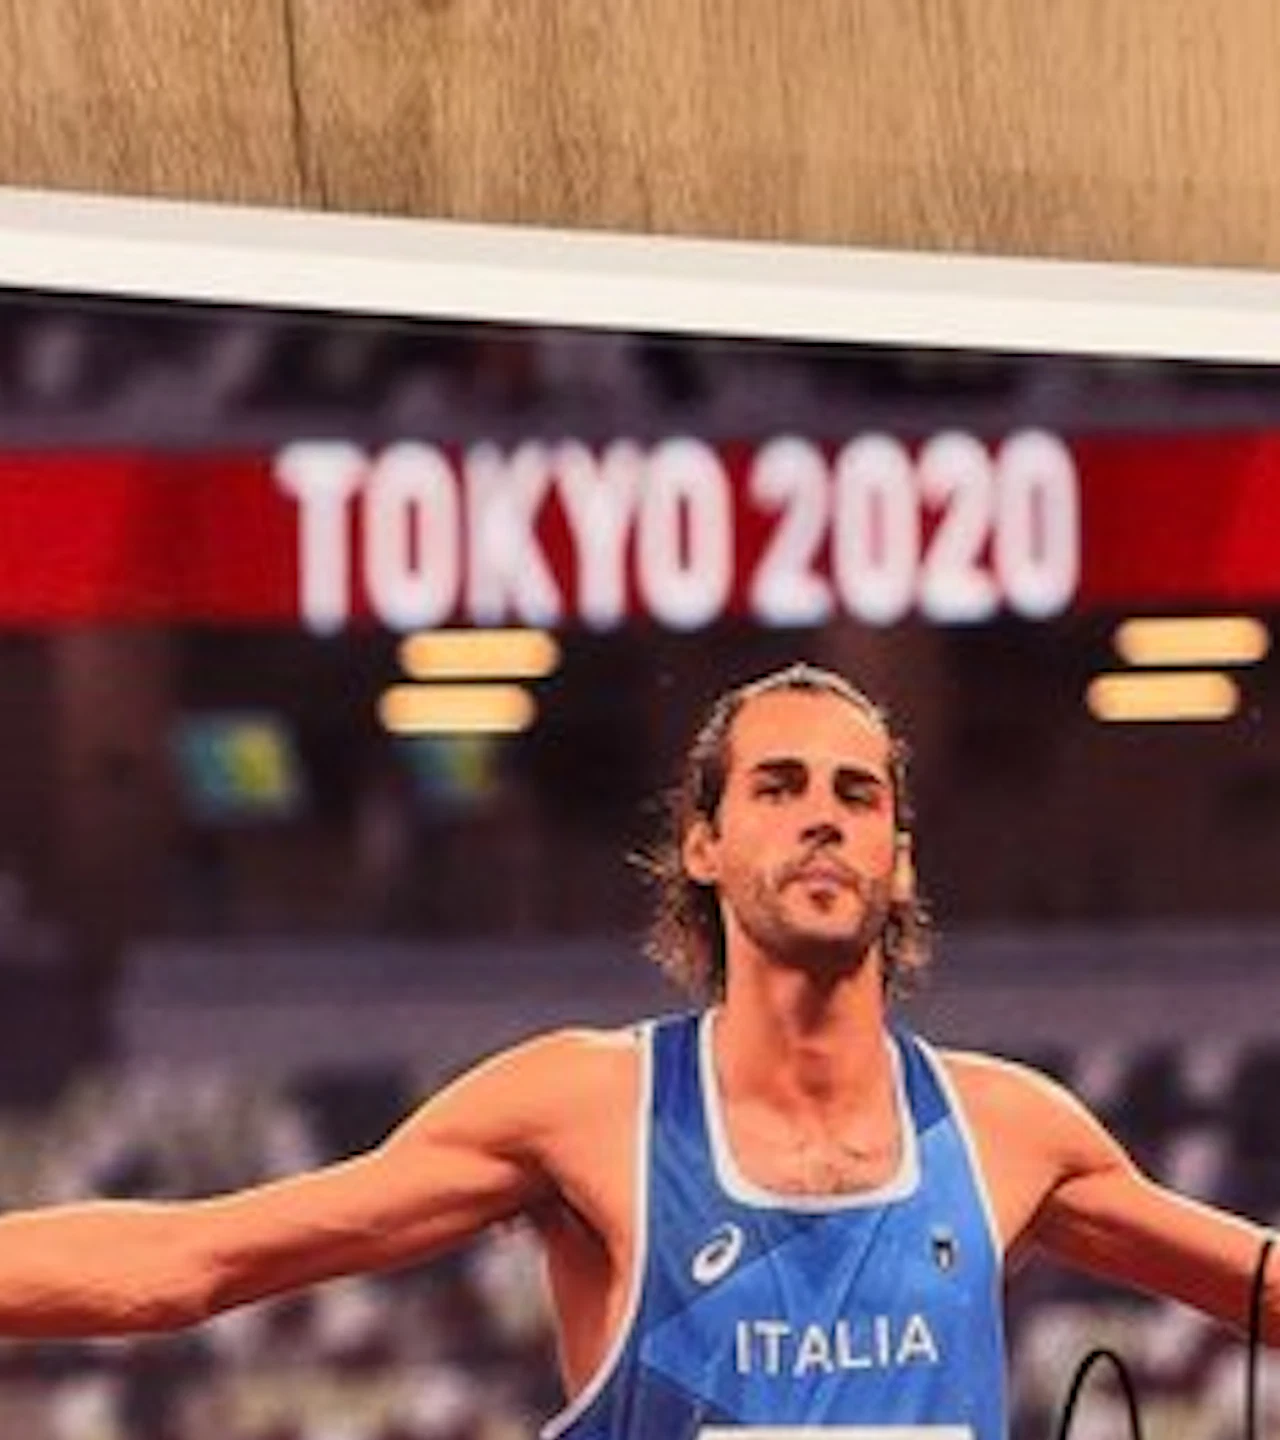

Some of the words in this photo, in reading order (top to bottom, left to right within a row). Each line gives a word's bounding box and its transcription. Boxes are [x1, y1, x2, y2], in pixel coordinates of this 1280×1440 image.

[276, 438, 732, 634] TOKYO
[749, 430, 1080, 627] 2020
[735, 1312, 939, 1376] ITALIA
